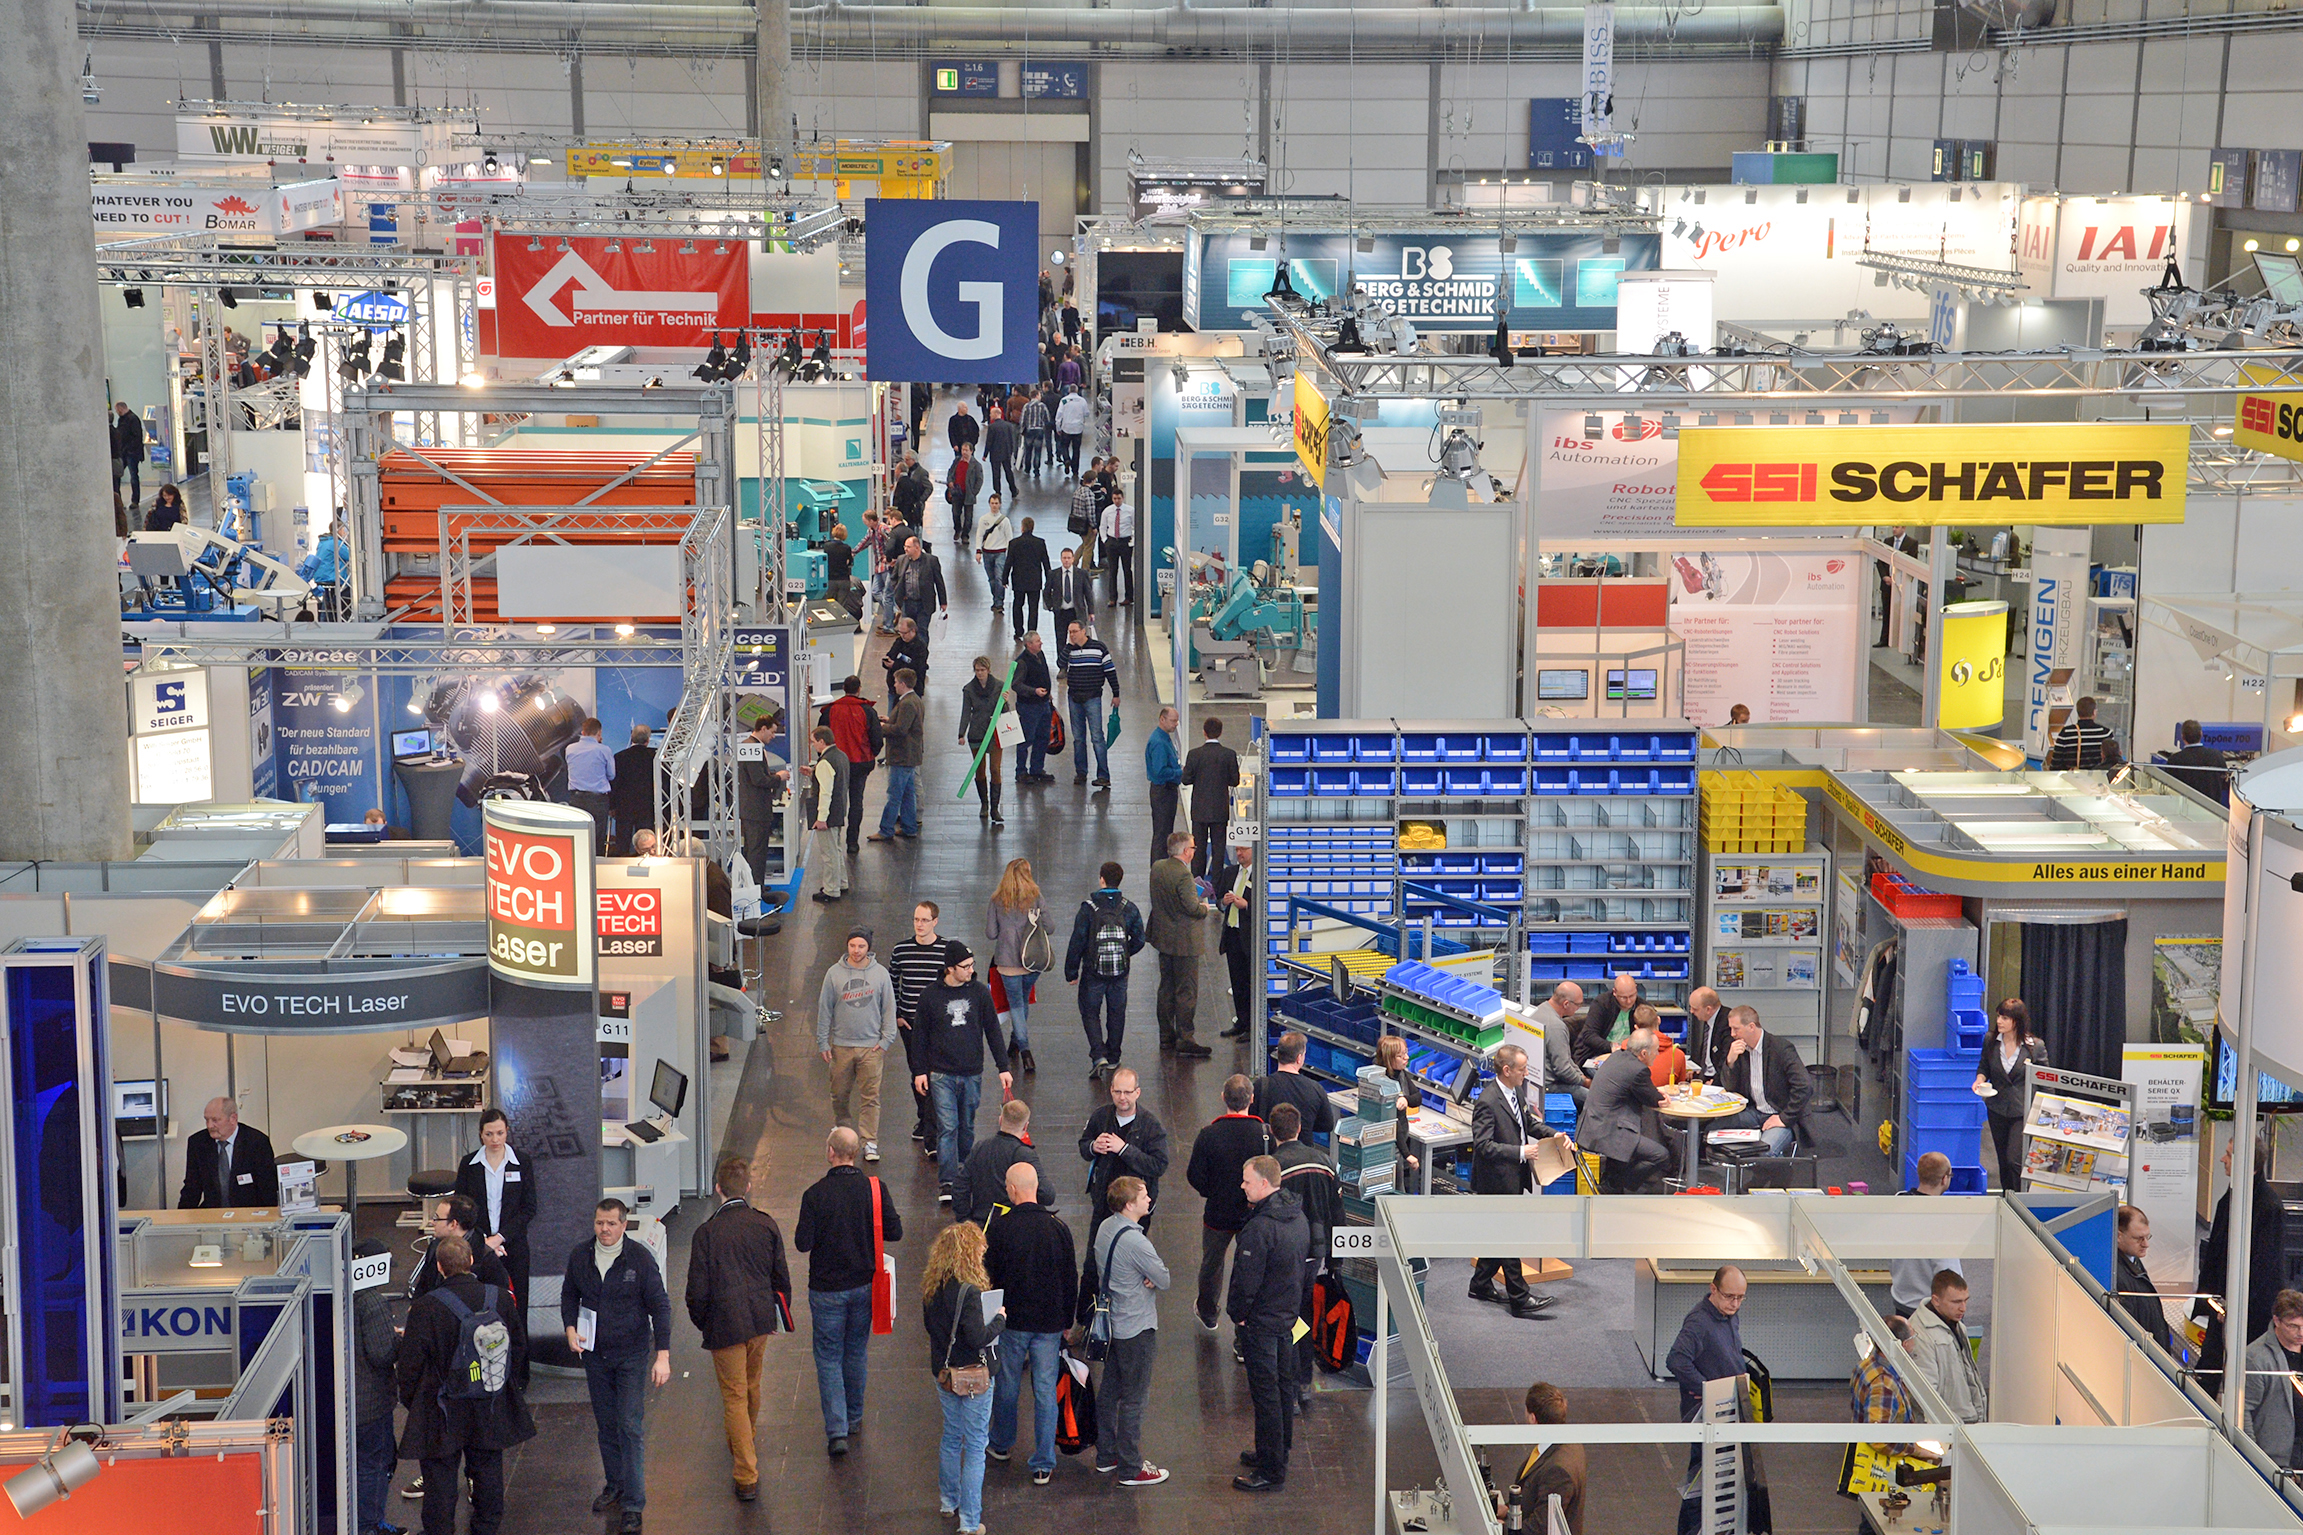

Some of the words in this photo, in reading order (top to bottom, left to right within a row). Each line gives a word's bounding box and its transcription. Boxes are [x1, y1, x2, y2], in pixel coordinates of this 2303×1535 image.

[972, 63, 983, 72] 1.6
[261, 144, 298, 156] WEIGEL
[164, 197, 193, 208] YOU
[1139, 192, 1202, 204] Zuverlässigkeit
[134, 213, 149, 223] TO
[154, 214, 182, 224] CUT
[205, 214, 256, 230] BOMAR
[1693, 221, 1771, 259] Pero
[1901, 233, 1932, 241] Cleaning
[2023, 223, 2050, 261] IAI
[2077, 225, 2169, 261] IAI
[1907, 249, 1940, 257] Nettoyage
[1953, 247, 1976, 255] Pièces
[2065, 262, 2101, 274] Quality
[2103, 263, 2122, 273] and
[2124, 263, 2169, 273] Innovatio
[900, 219, 1003, 361] G
[1356, 282, 1404, 297] BERG
[1407, 282, 1421, 297] &
[1422, 282, 1496, 298] SCHMID
[1377, 298, 1496, 314] GETECHNIK
[572, 310, 630, 326] Partner
[632, 309, 654, 325] für
[655, 312, 718, 327] Technik
[1932, 289, 1956, 347] ifs
[2241, 396, 2276, 436] SSI
[1553, 436, 1594, 450] ibs
[838, 460, 870, 468] KALTENBACH
[1549, 451, 1659, 466] Automation
[1699, 463, 1818, 503] SSI
[1829, 460, 2165, 502] SCHÄFER
[1807, 572, 1822, 581] ibs
[2012, 571, 2030, 580] H24
[2112, 573, 2131, 590] ifs
[1807, 582, 1845, 591] Automation
[1684, 617, 1693, 625] Ihr
[1694, 617, 1717, 625] Partner
[2057, 579, 2073, 668] RKZEUGBAU
[793, 653, 812, 661] G21
[303, 684, 334, 692] präsentiert
[2242, 679, 2265, 688] H22
[281, 692, 323, 707] ZW
[150, 714, 194, 728] SEIGER
[277, 727, 298, 738] "Der
[300, 727, 325, 738] neue
[326, 726, 371, 738] Standard
[2203, 734, 2233, 745] TapOne
[2234, 734, 2251, 742] 700
[289, 744, 303, 755] für
[305, 744, 359, 755] bezahlbare
[739, 747, 761, 756] G15
[287, 759, 363, 777] CAD/CAM
[1236, 826, 1259, 835] G12
[1874, 819, 1905, 856] SCHÄFER
[486, 832, 563, 881] EVO
[2033, 863, 2076, 880] Alles
[2078, 866, 2110, 880] aus
[2114, 864, 2157, 880] einer
[2161, 863, 2206, 880] Hand
[488, 877, 563, 924] TECH
[597, 893, 656, 911] EVO
[597, 915, 656, 932] TECH
[489, 919, 564, 968] Laser
[598, 937, 656, 954] Laser
[221, 993, 269, 1014] EVO
[274, 995, 340, 1015] TECH
[348, 993, 408, 1014] Laser
[602, 1024, 629, 1036] G11
[2035, 1070, 2059, 1082] SSI
[2060, 1074, 2127, 1096] SCHÄFER
[2148, 1078, 2187, 1086] BEHÄLTER-
[2170, 1087, 2181, 1095] QX
[1333, 1234, 1373, 1248] G08
[353, 1261, 387, 1281] G09
